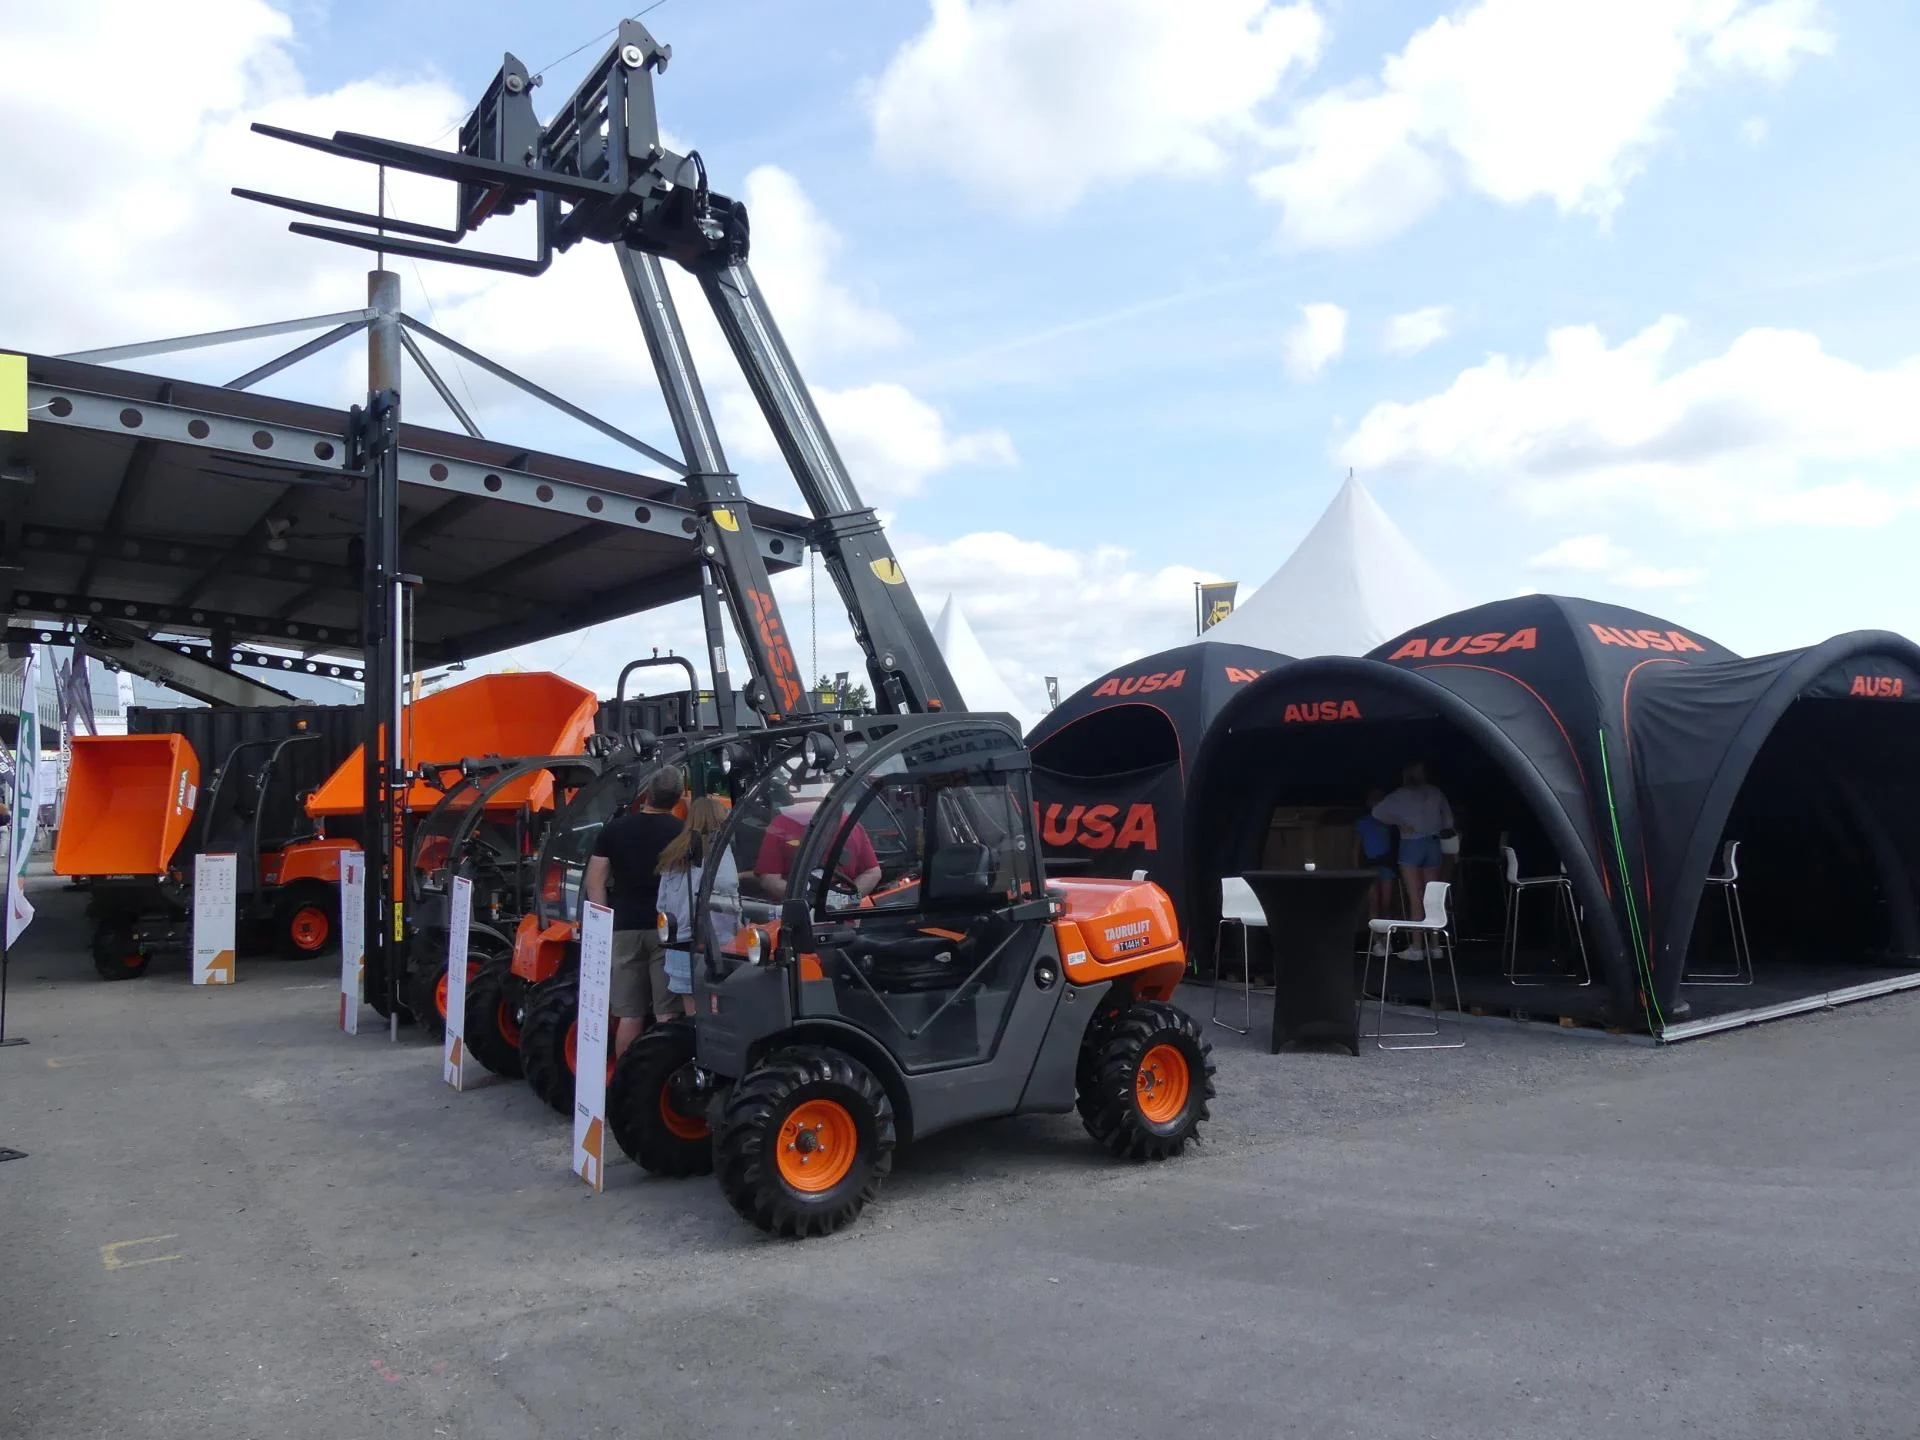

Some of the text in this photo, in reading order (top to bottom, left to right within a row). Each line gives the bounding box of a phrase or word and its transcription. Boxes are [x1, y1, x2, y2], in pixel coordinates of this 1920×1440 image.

[746, 586, 802, 712] AUSA
[1389, 628, 1538, 660] AUSA
[1588, 623, 1706, 652] AUSA
[1092, 669, 1187, 697] AUSA
[1849, 676, 1905, 698] AUSA
[1283, 699, 1361, 723] AUSA
[394, 796, 404, 849] AUSA
[1104, 919, 1151, 942] TAURULIFT
